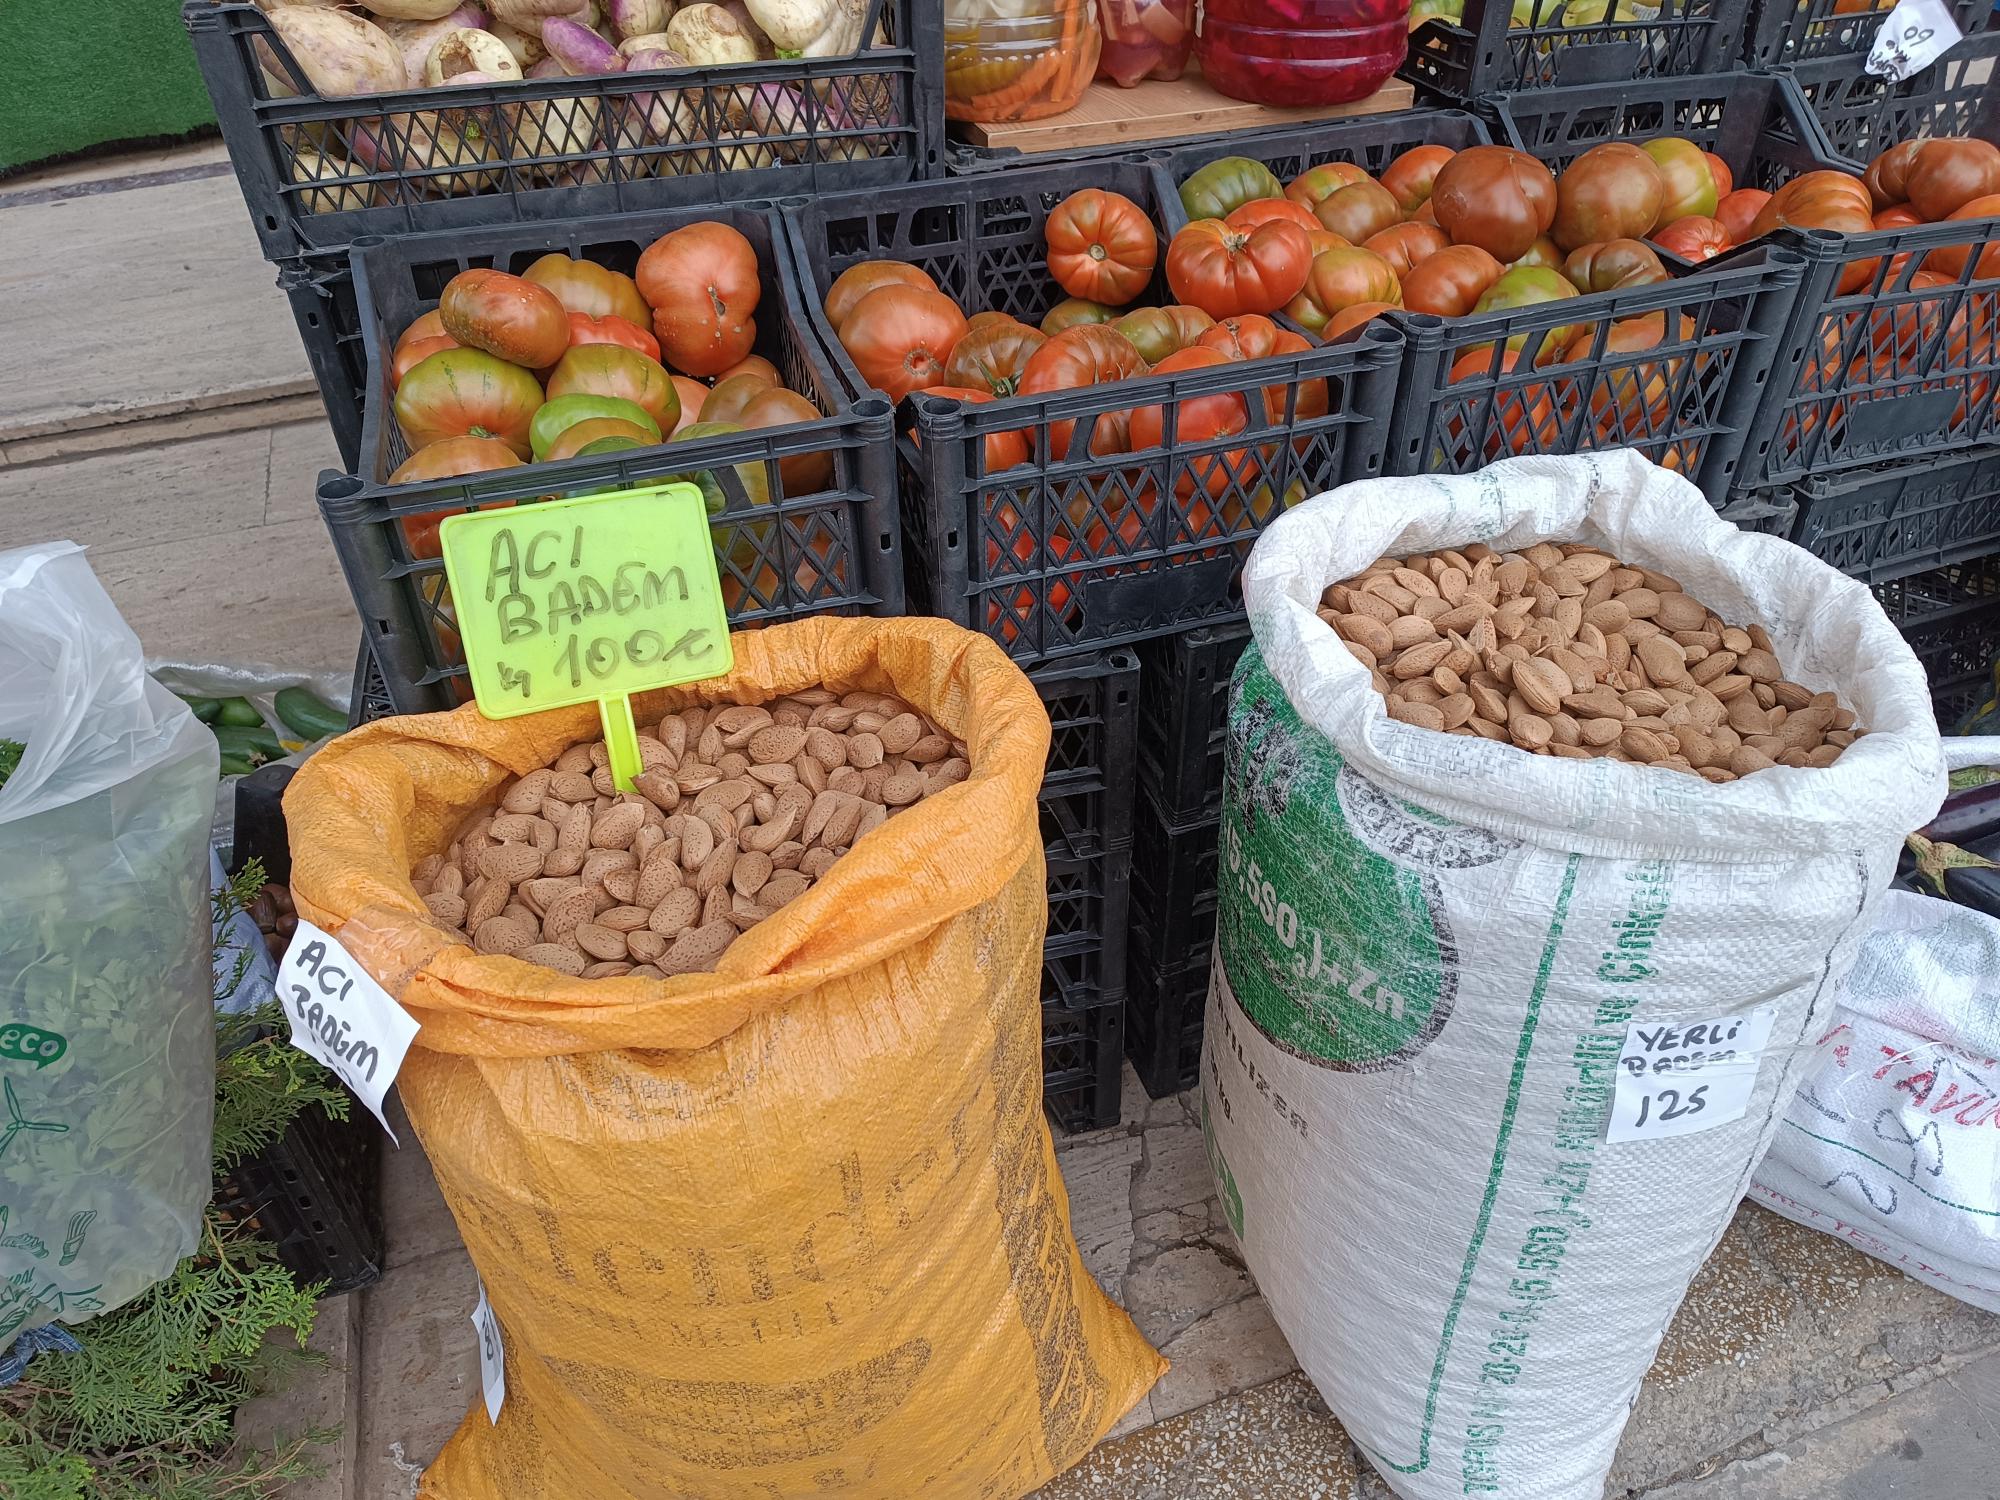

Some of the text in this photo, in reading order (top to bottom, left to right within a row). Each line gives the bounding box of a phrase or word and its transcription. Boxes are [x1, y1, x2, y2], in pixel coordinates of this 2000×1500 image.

[485, 525, 583, 602] ACI
[296, 940, 353, 1001] ACI
[1, 1028, 60, 1058] eco
[1635, 1084, 1710, 1128] 125
